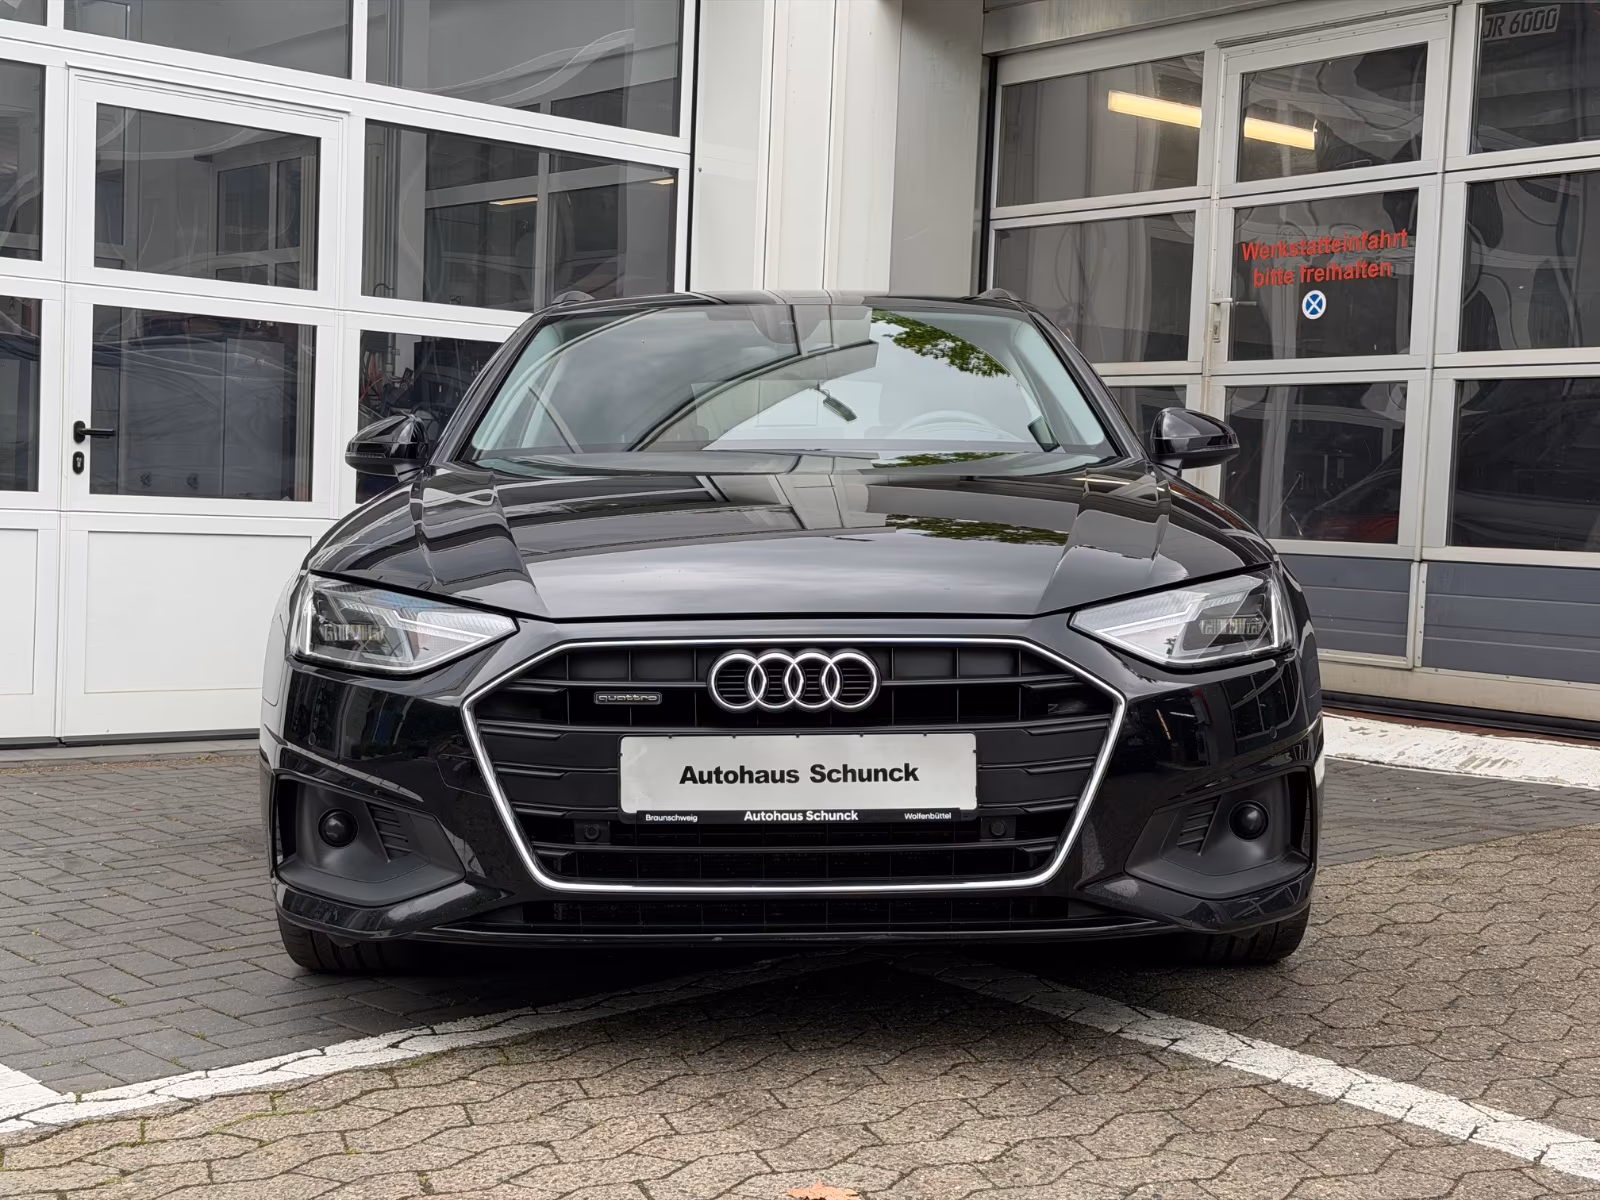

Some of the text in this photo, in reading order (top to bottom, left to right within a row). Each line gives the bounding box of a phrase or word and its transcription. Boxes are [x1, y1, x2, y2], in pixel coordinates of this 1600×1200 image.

[1509, 8, 1558, 35] 6000
[1242, 228, 1409, 261] Werkstatteinfahrt
[1253, 260, 1393, 288] bitte freihalten
[598, 694, 657, 702] quattro
[679, 763, 920, 784] Autohaus Schunck
[645, 813, 698, 822] Braunschweig
[744, 809, 859, 821] Autohaus Schunck
[904, 811, 952, 820] Wolfenbüttel
